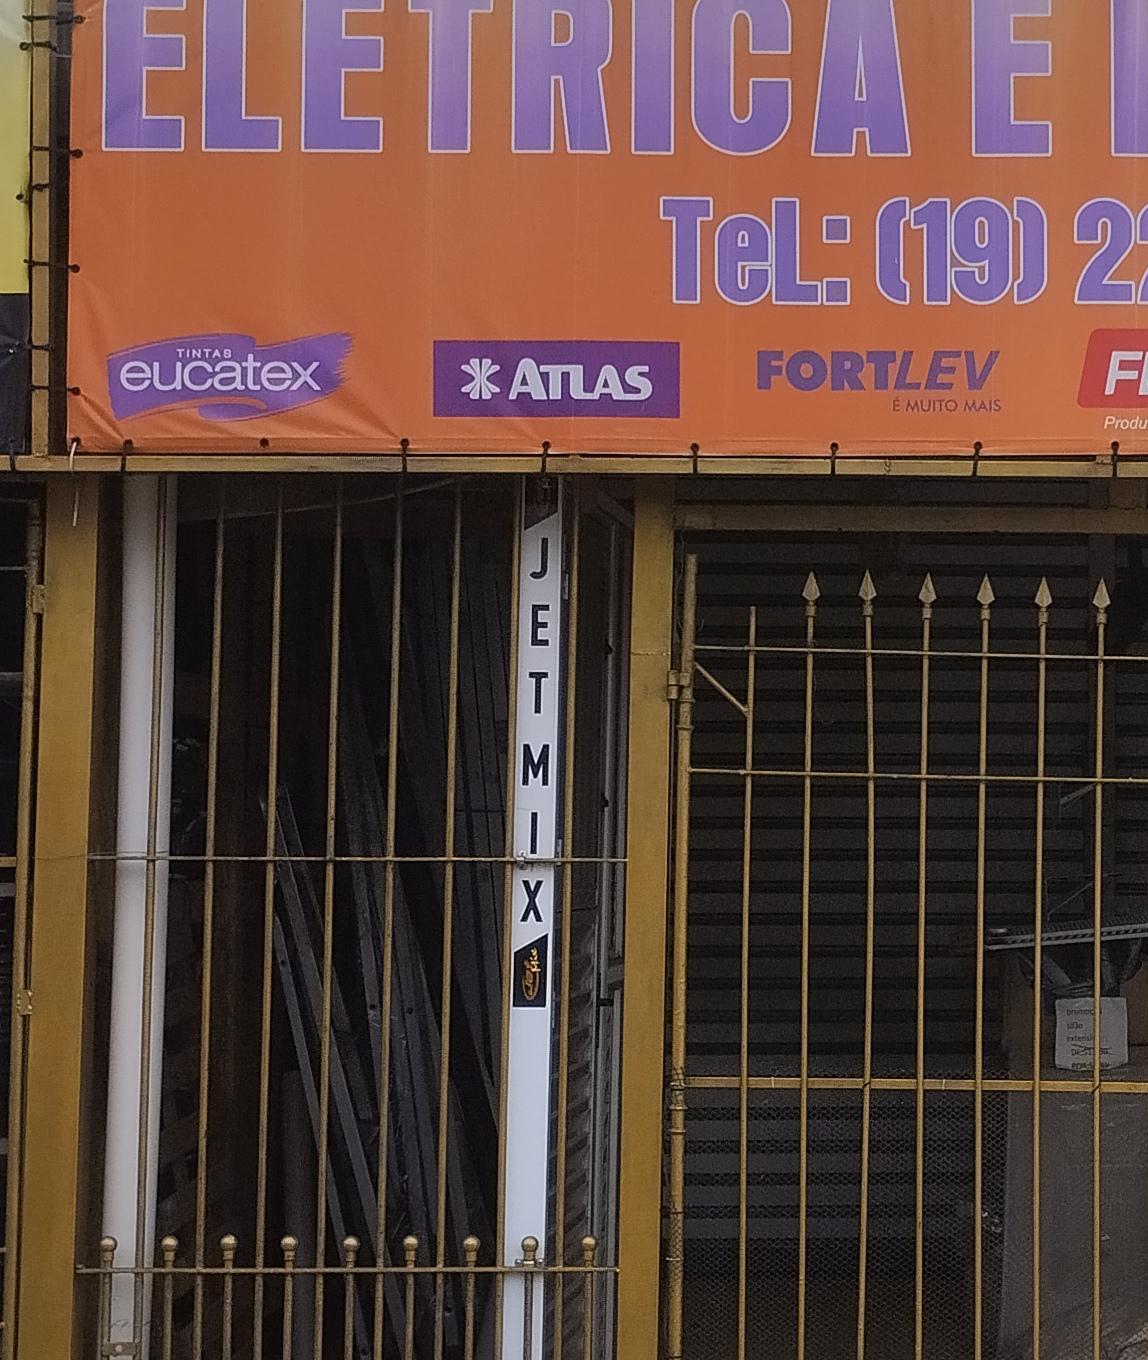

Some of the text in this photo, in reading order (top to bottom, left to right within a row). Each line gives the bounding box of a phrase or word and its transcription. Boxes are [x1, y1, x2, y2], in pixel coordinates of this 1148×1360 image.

[875, 196, 1047, 306] (19)
[120, 354, 321, 391] eucatex
[176, 348, 232, 359] TINTAS
[757, 350, 1000, 391] FORTLEV
[508, 357, 653, 401] ATLAS
[905, 399, 958, 413] MUITO
[963, 400, 1002, 413] MAIS
